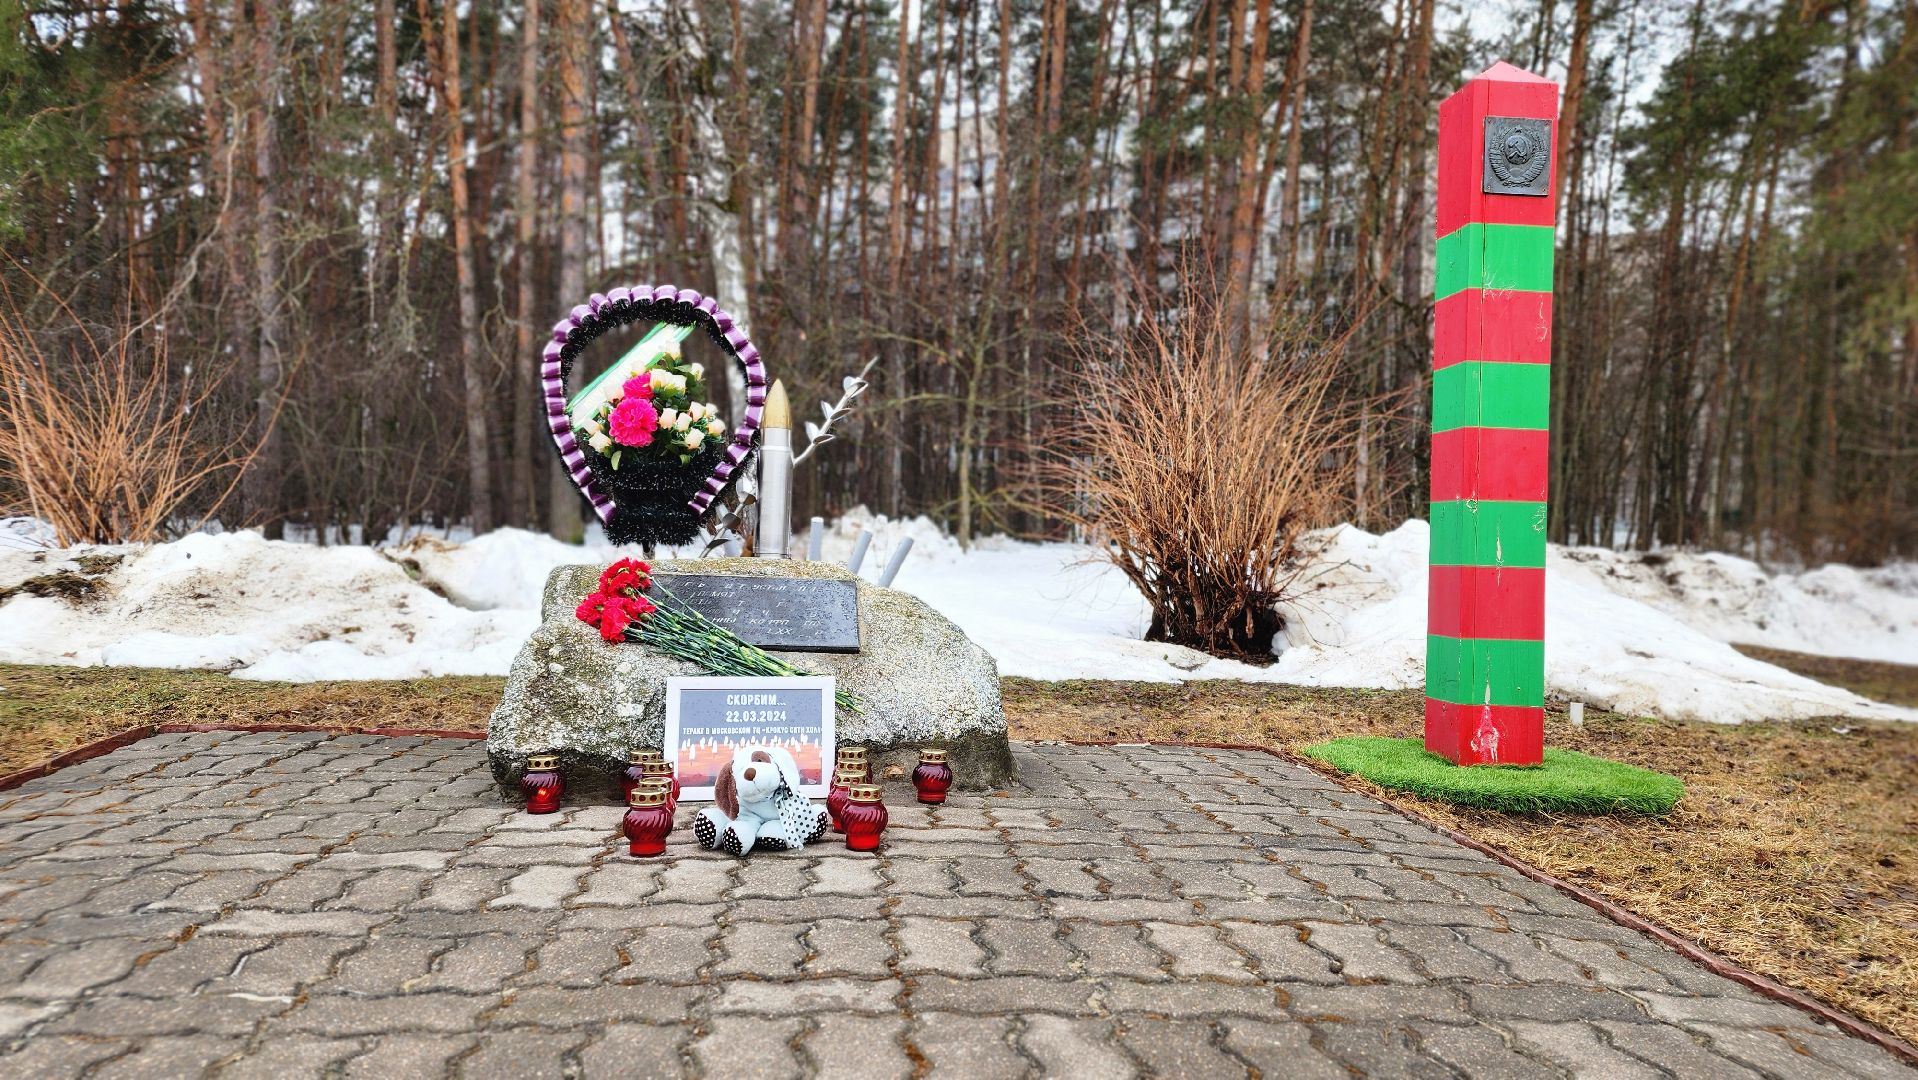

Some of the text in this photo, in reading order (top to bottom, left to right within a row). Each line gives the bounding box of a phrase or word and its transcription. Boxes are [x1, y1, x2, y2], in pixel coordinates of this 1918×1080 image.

[726, 694, 787, 706] СКОРБИМ...
[725, 710, 787, 722] 22.03.2024
[682, 727, 705, 735] ТЕРАКТ
[705, 727, 710, 735] В
[711, 726, 751, 735] МОСКОВСКОМ
